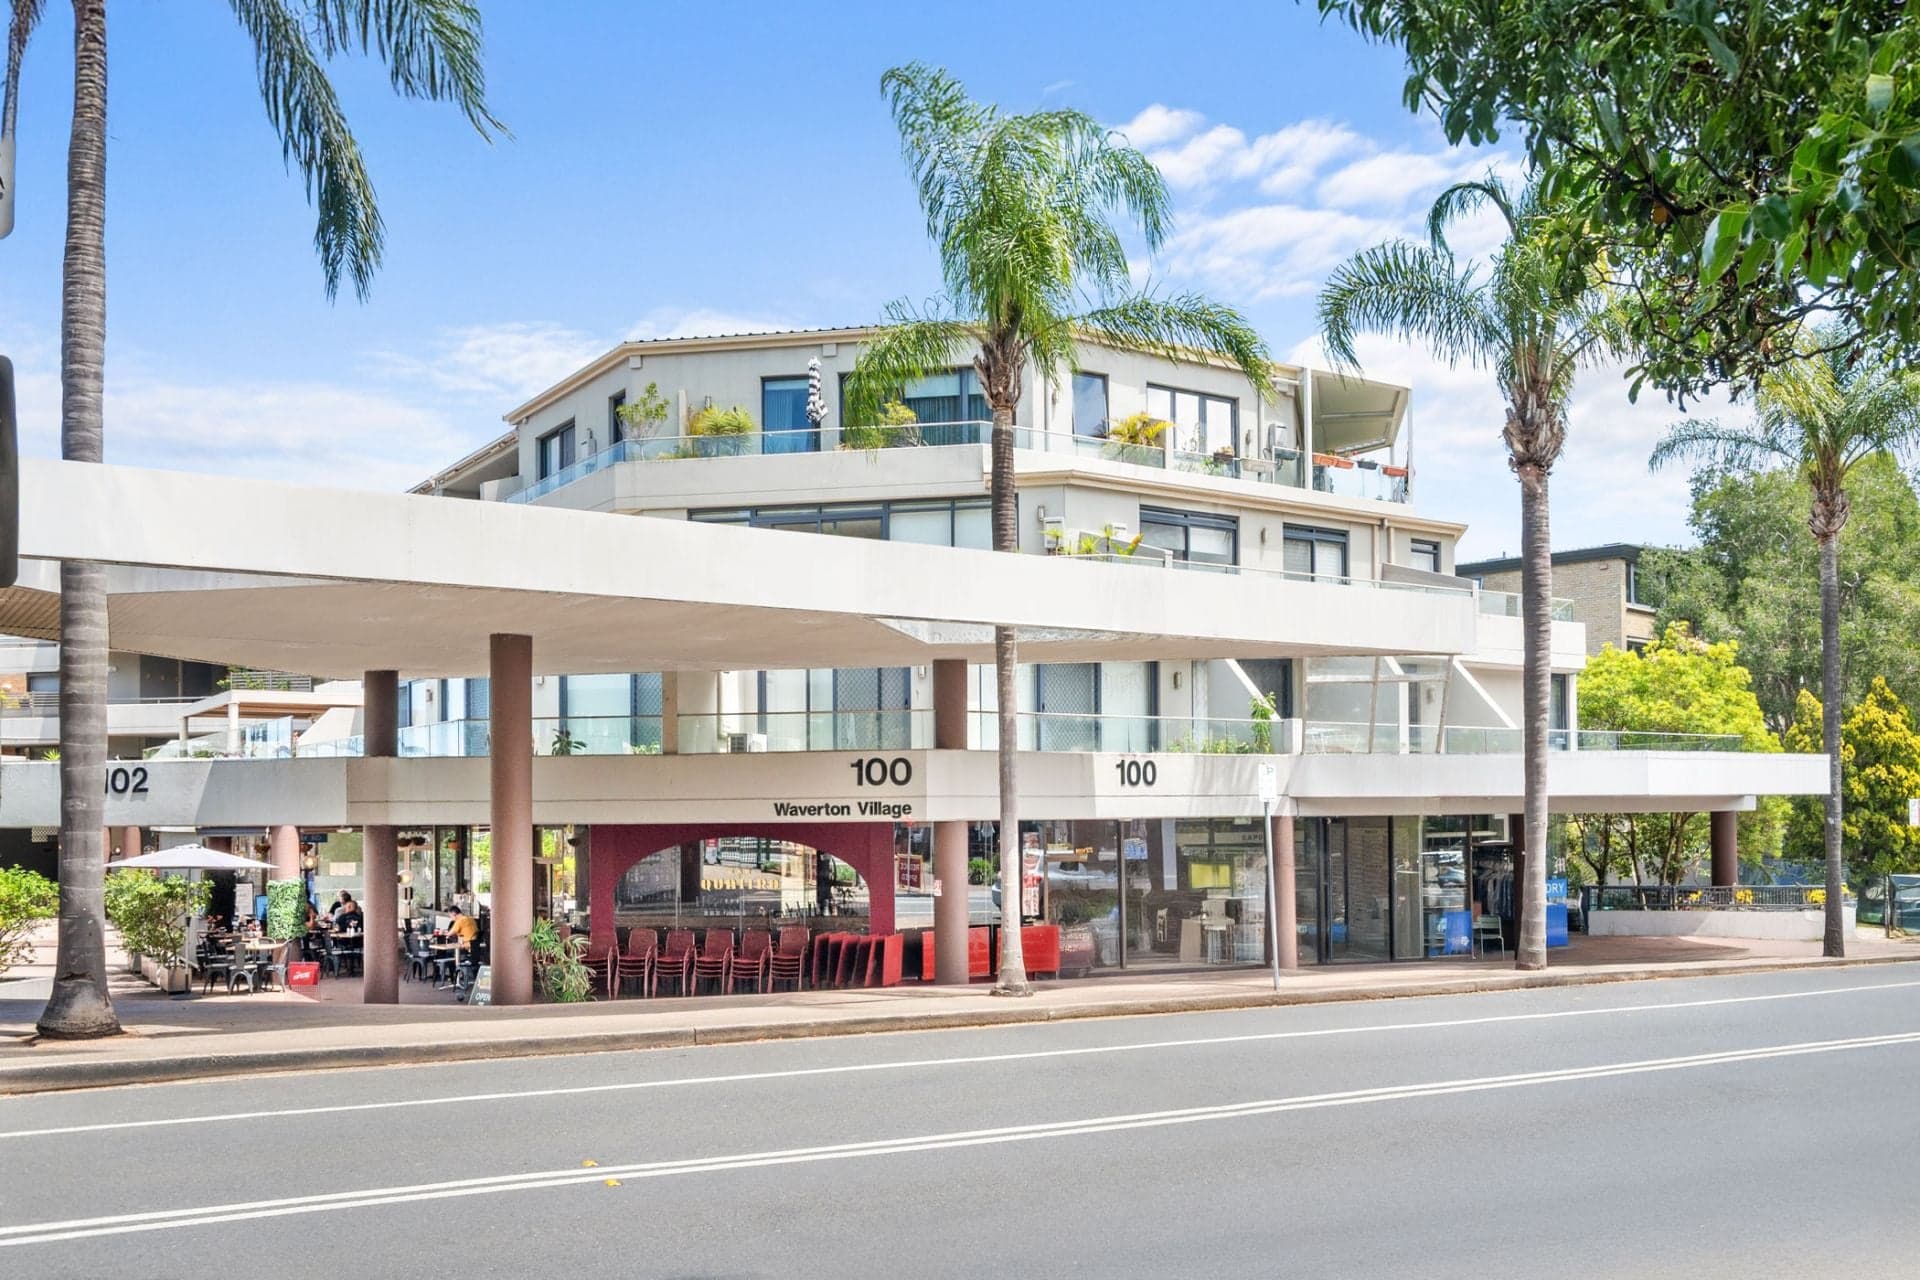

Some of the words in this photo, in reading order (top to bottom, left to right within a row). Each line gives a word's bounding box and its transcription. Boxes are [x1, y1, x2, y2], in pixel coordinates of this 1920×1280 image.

[850, 757, 912, 786] 100
[1115, 759, 1157, 787] 100
[774, 802, 850, 817] Waverton
[857, 801, 912, 818] Village
